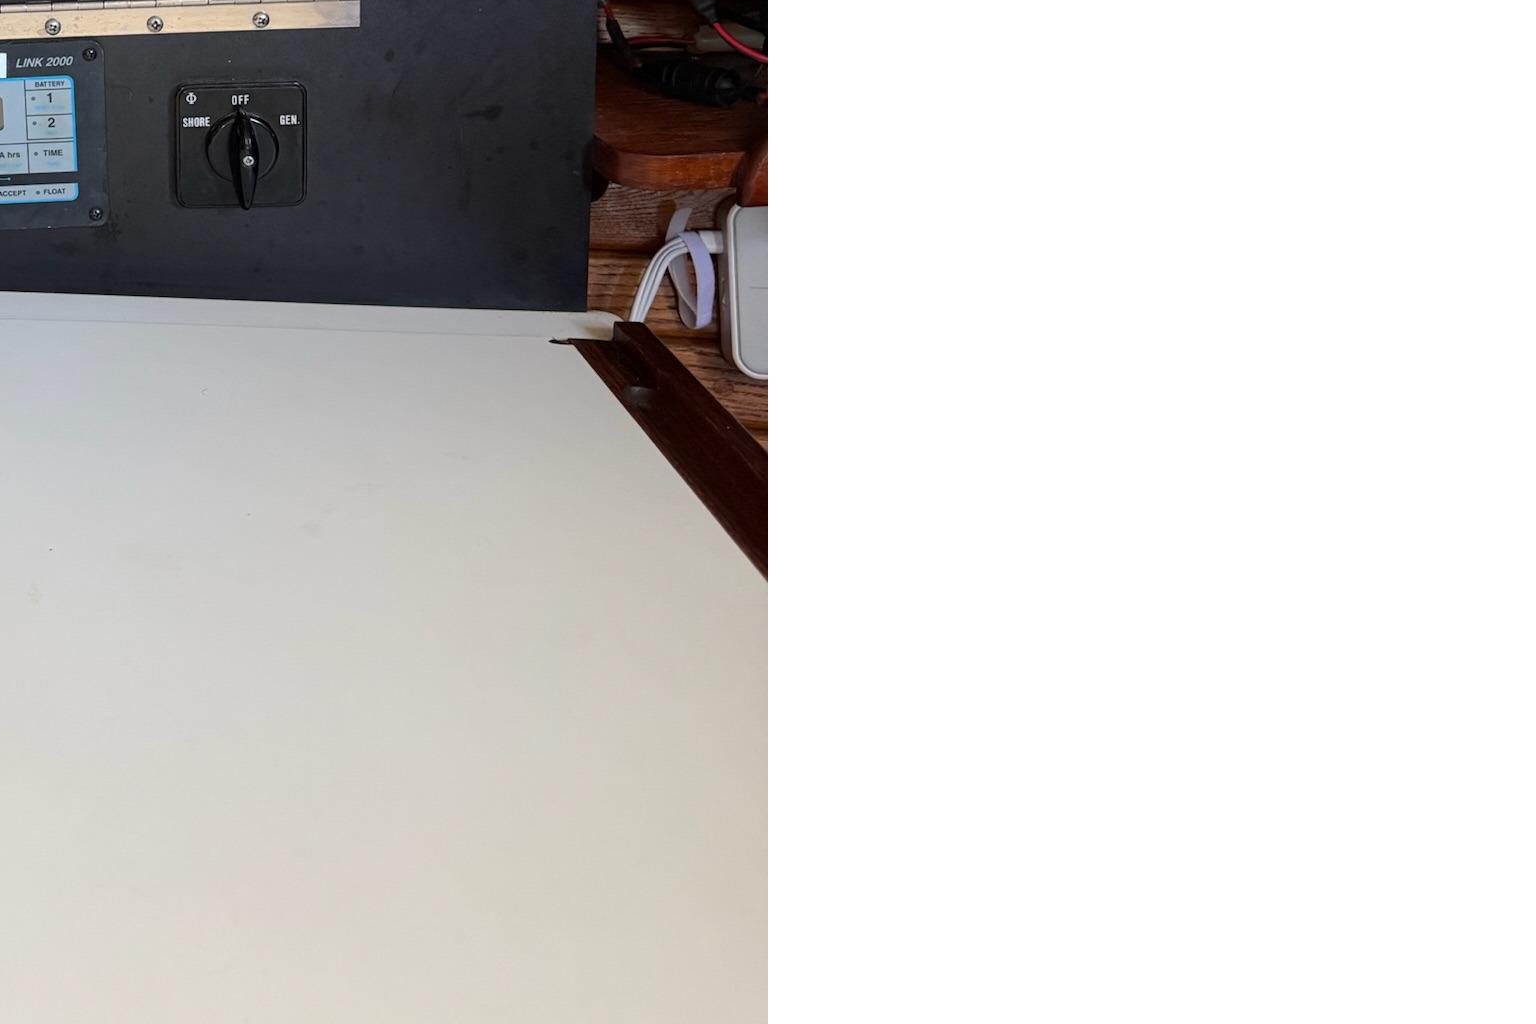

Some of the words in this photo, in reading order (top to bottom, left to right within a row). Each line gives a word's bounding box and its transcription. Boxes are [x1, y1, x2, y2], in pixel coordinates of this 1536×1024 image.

[15, 58, 44, 69] LINK
[46, 56, 74, 68] 2000
[34, 80, 65, 88] BATTERY
[46, 92, 53, 104] 1
[231, 94, 250, 106] OFF
[47, 117, 56, 128] 2
[182, 116, 211, 128] SHORE
[279, 114, 301, 126] GEN.
[43, 149, 64, 157] TIME
[43, 187, 66, 196] FLOAT
